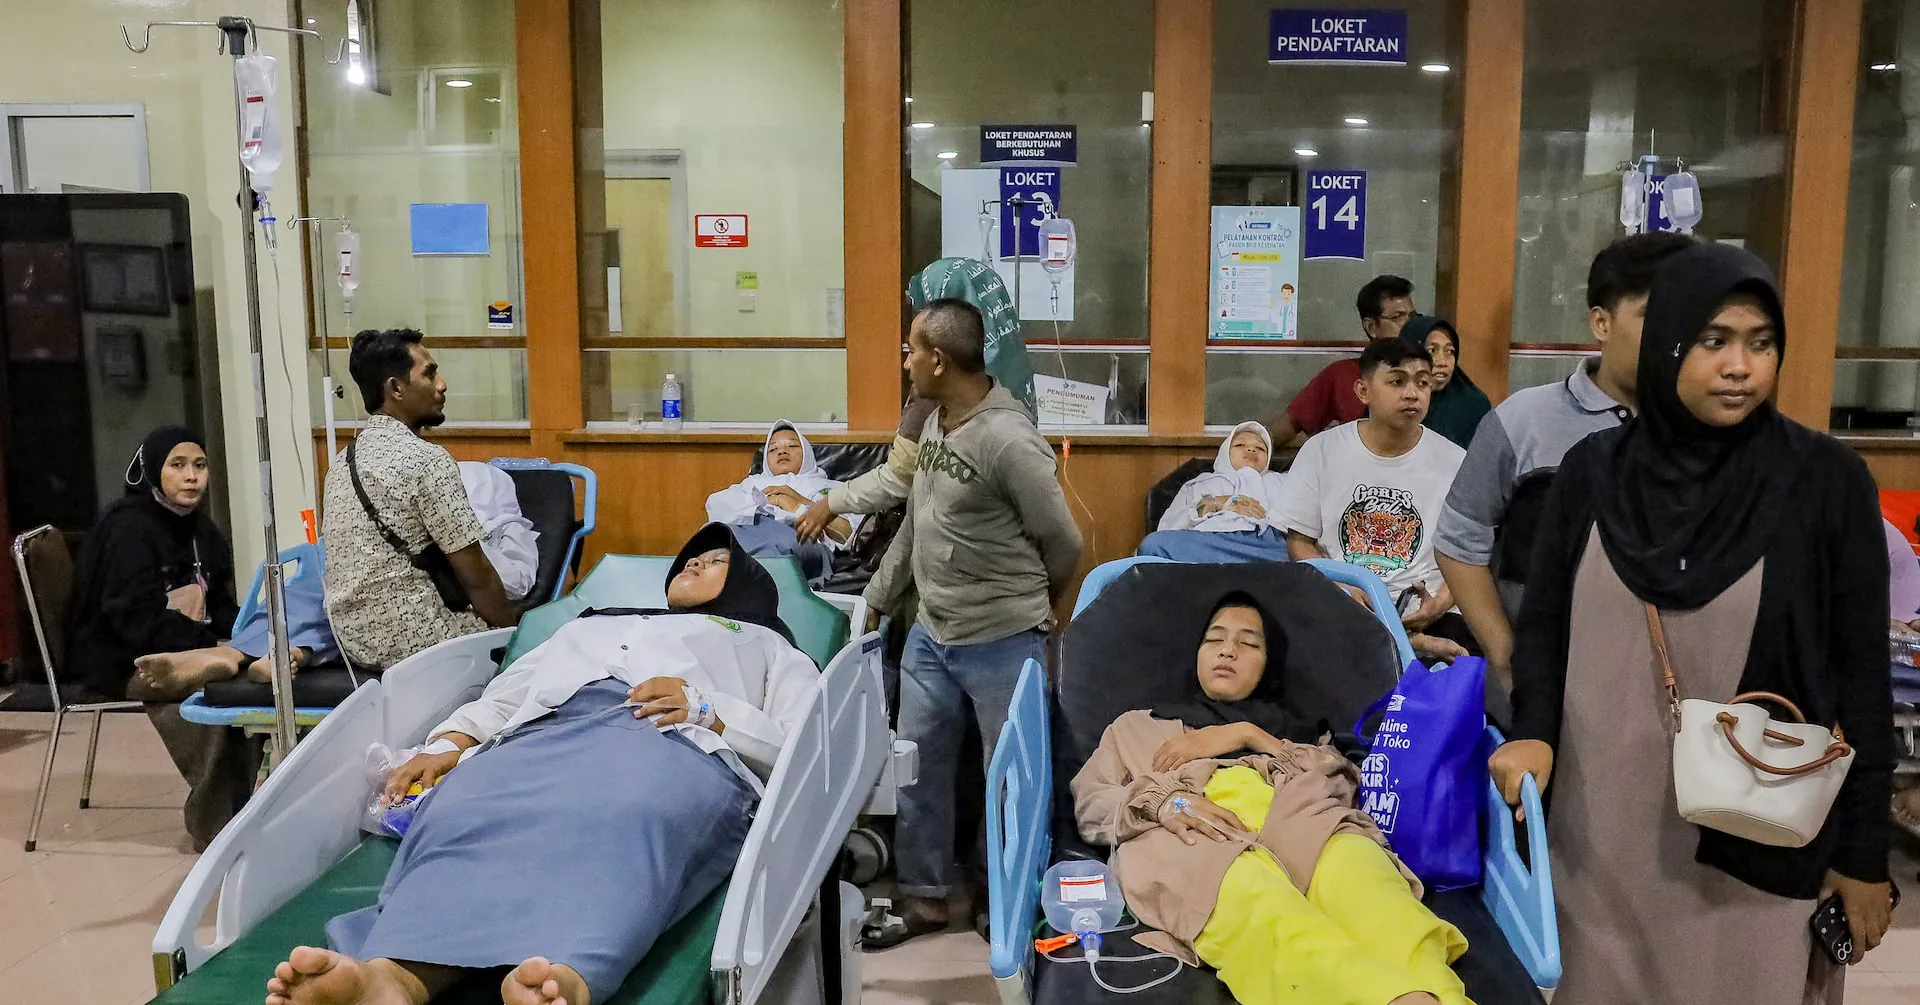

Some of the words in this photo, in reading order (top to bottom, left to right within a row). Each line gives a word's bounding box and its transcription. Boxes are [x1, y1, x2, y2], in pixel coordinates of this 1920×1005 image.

[1311, 18, 1367, 34] LOKET
[1277, 36, 1399, 53] PENDAFTARAN
[985, 131, 1012, 139] LOKET
[1012, 131, 1072, 140] PENDAFTARAN
[996, 140, 1061, 148] BERKEBUTUHAN
[1012, 149, 1045, 157] KHUSUS
[1006, 172, 1055, 186] LOKET
[1312, 175, 1362, 190] LOKET
[1312, 194, 1359, 231] 14
[1258, 234, 1285, 242] KONTROL
[1364, 496, 1402, 514] Bali
[1379, 718, 1408, 733] nline
[1383, 733, 1411, 749] Toko
[1362, 756, 1384, 772] TIS
[1361, 773, 1383, 788] KIR
